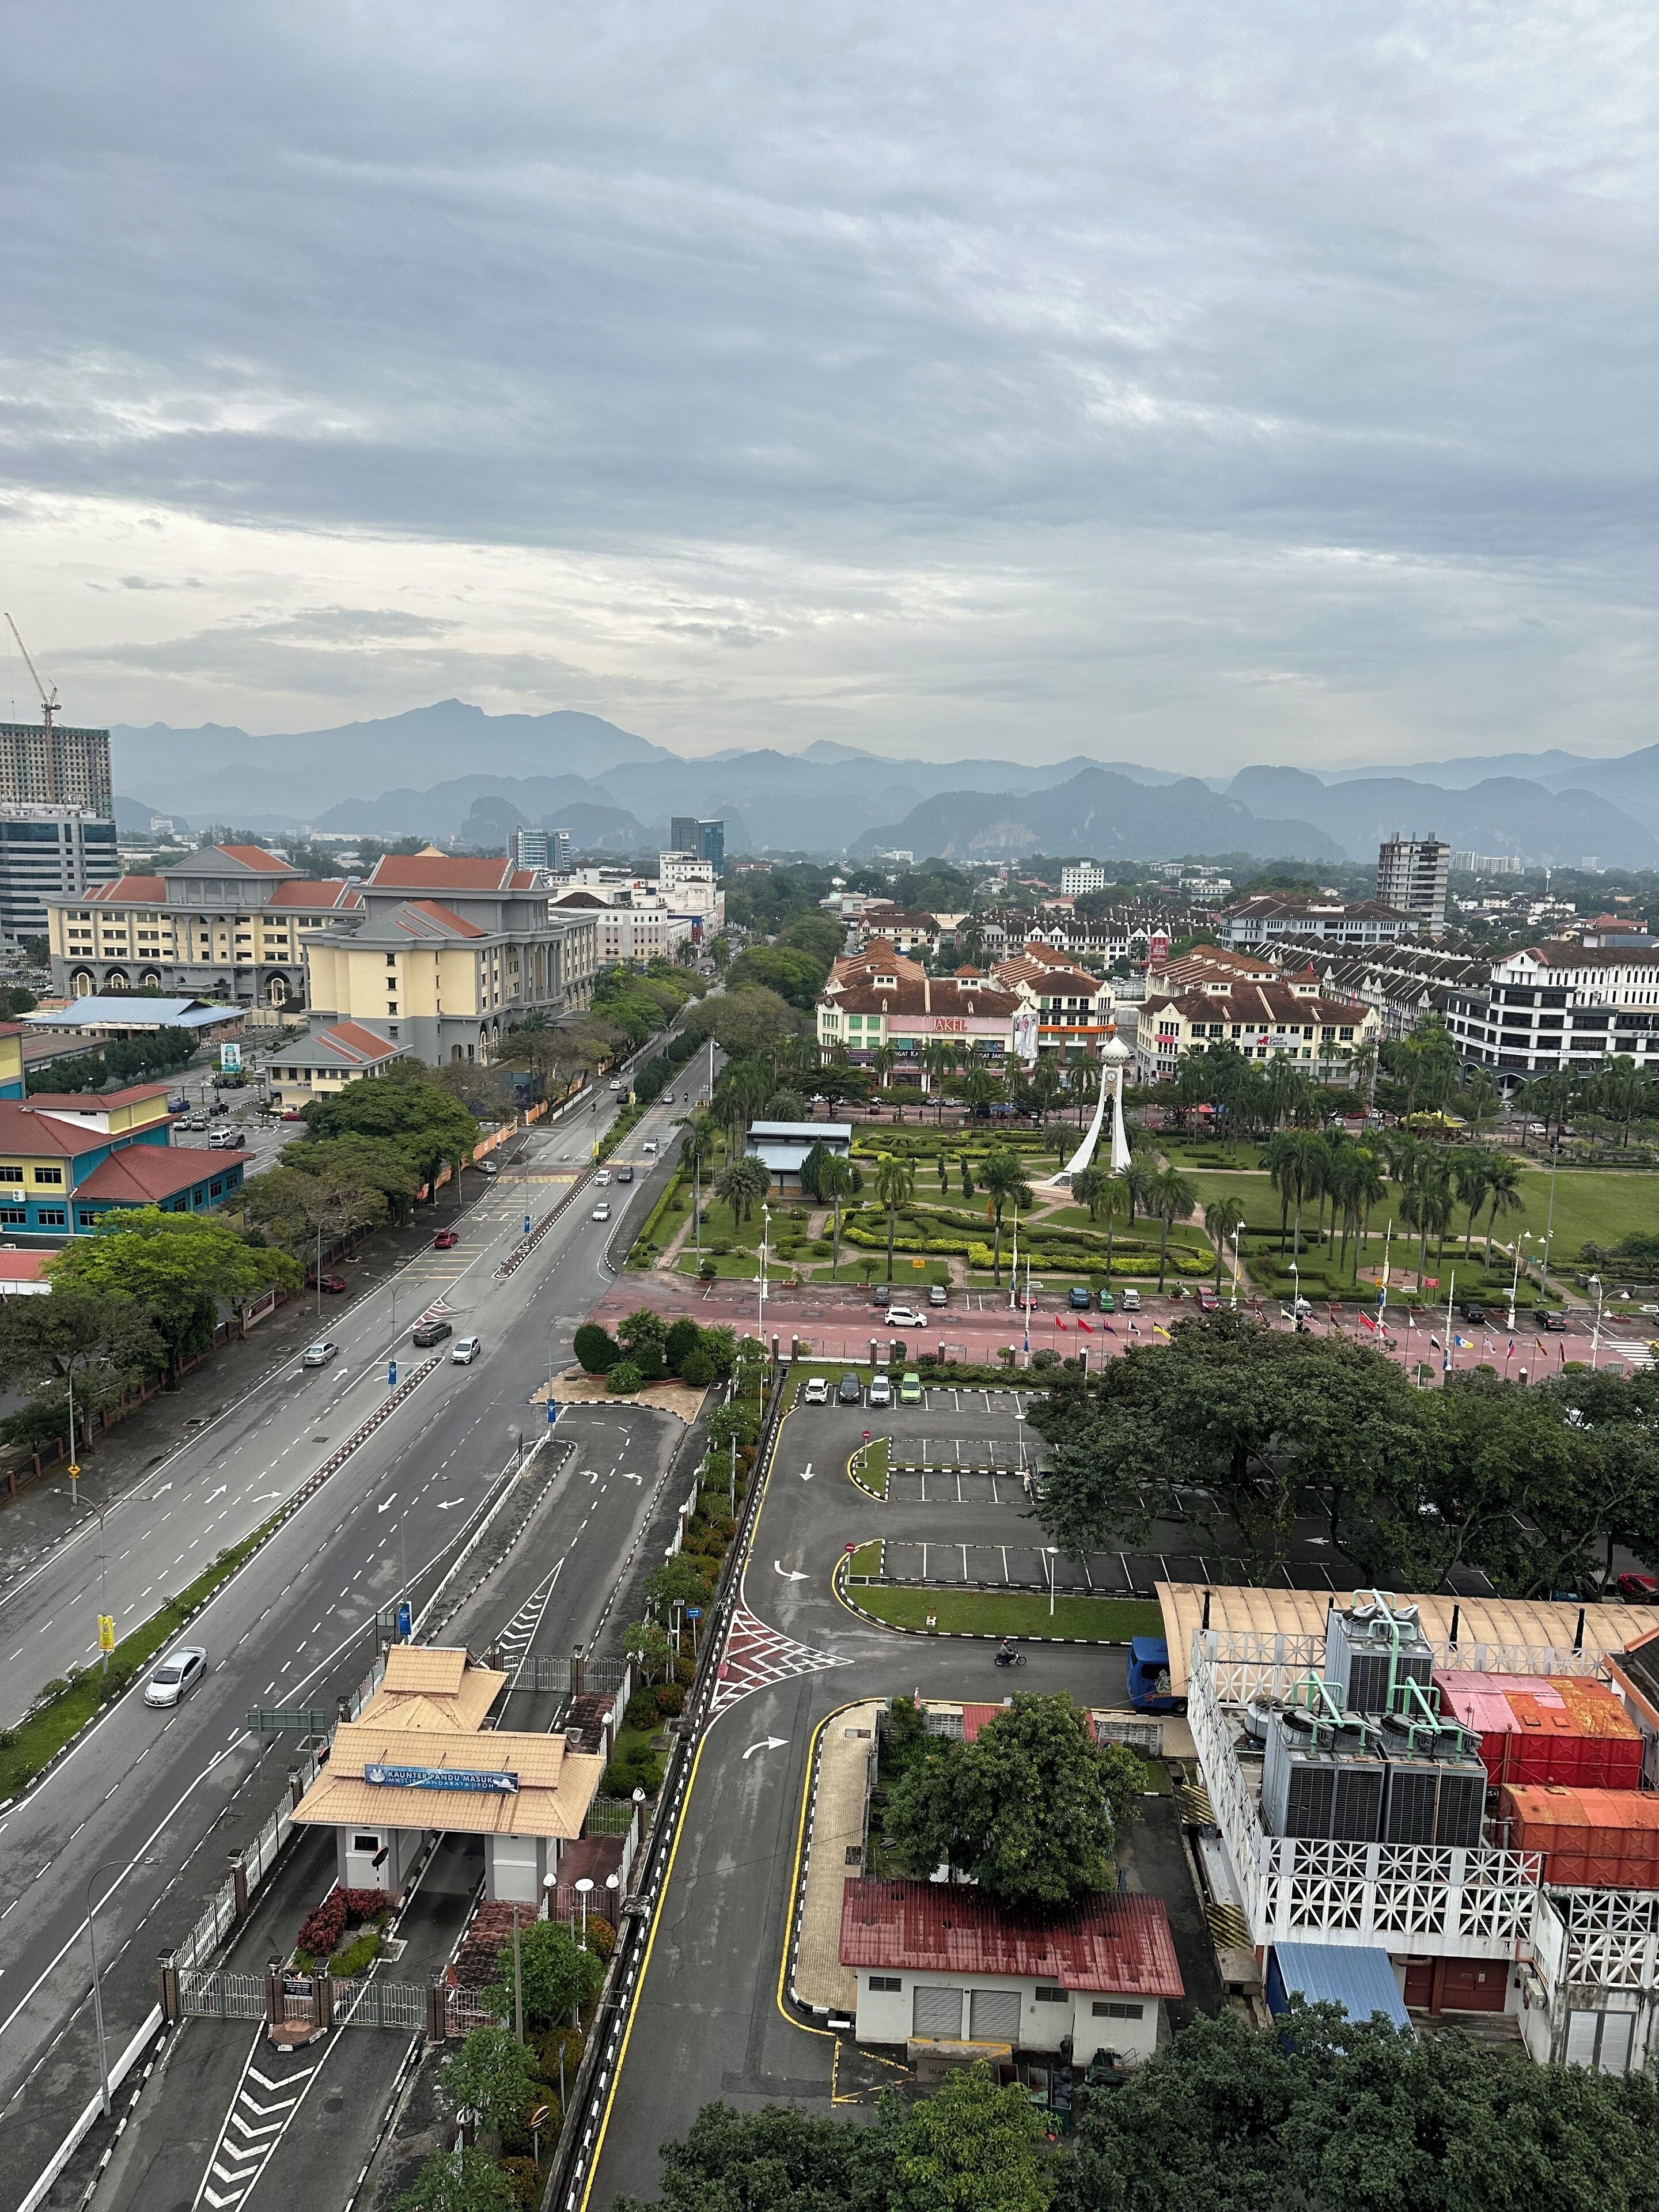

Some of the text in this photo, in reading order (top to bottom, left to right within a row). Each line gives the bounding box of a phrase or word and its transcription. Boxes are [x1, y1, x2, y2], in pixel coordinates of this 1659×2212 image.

[932, 1018, 967, 1031] JAKEL
[388, 1770, 494, 1783] KAUNTER PANDU MASUK
